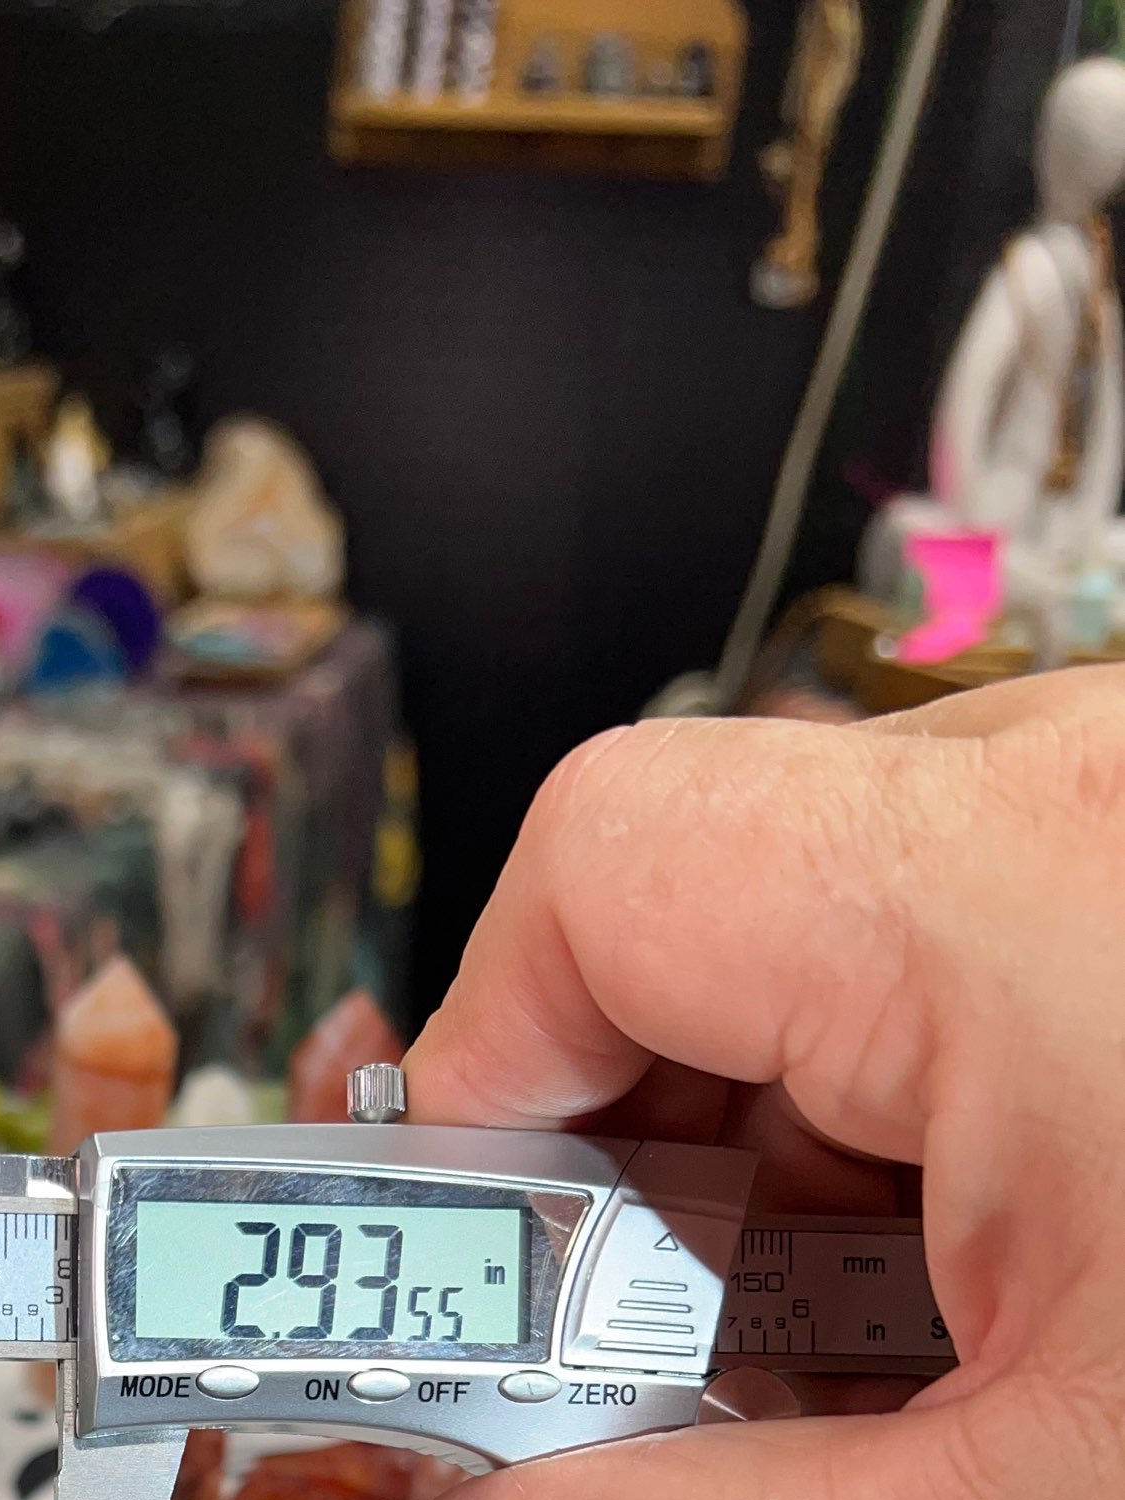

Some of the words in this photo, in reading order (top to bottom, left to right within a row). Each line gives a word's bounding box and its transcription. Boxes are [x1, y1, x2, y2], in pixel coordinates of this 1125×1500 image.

[483, 1258, 506, 1286] in
[842, 1255, 886, 1275] mm
[730, 1271, 785, 1293] 150
[1, 1303, 14, 1317] 8
[27, 1303, 39, 1318] 9
[45, 1285, 64, 1305] 3
[726, 1316, 738, 1330] 7
[750, 1316, 763, 1330] 8
[774, 1316, 787, 1331] 9
[791, 1298, 811, 1319] 6
[865, 1319, 886, 1342] in
[120, 1375, 191, 1399] MODE
[305, 1378, 341, 1400] ON
[417, 1380, 471, 1403] OFF
[566, 1382, 637, 1407] ZERO
